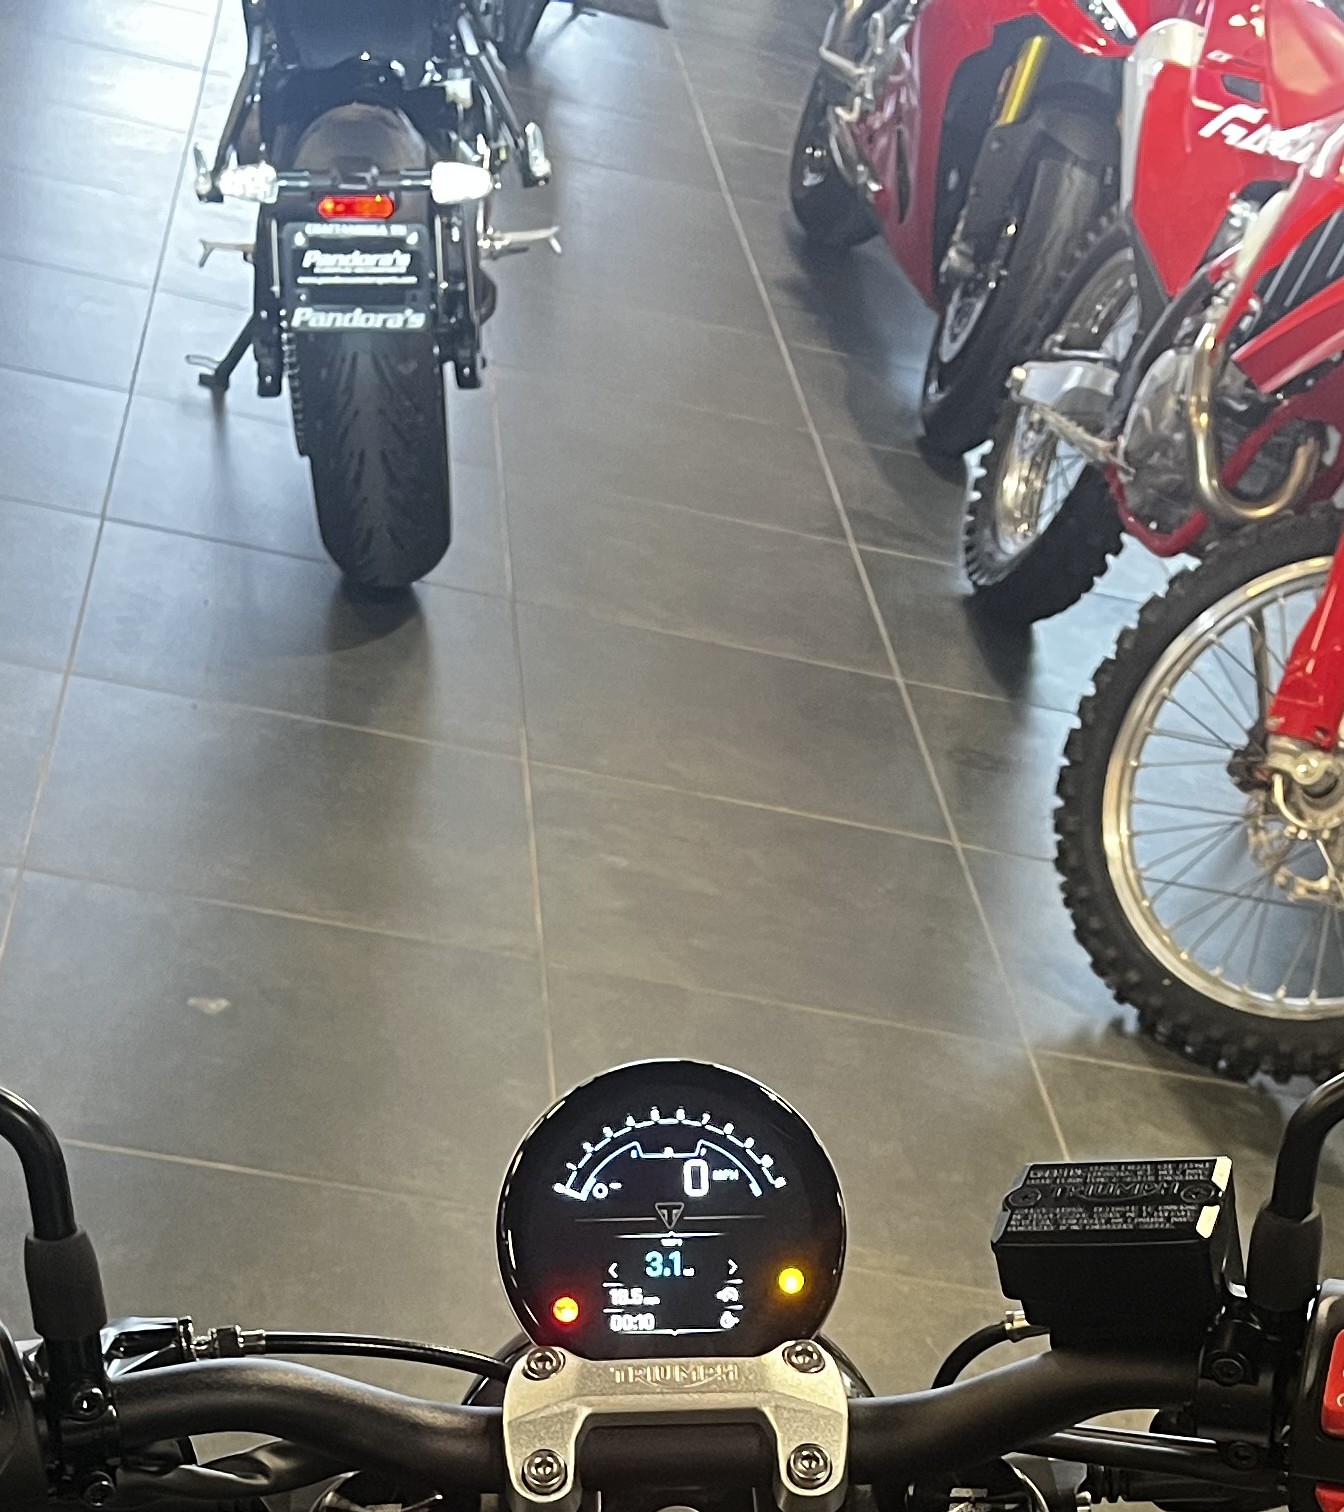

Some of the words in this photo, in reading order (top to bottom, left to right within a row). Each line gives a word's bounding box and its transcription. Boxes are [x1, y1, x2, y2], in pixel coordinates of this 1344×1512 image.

[291, 306, 426, 328] Pandora's
[683, 1158, 709, 1197] 0
[645, 1250, 683, 1277] 3.1
[609, 1363, 739, 1385] TRIUMPH
